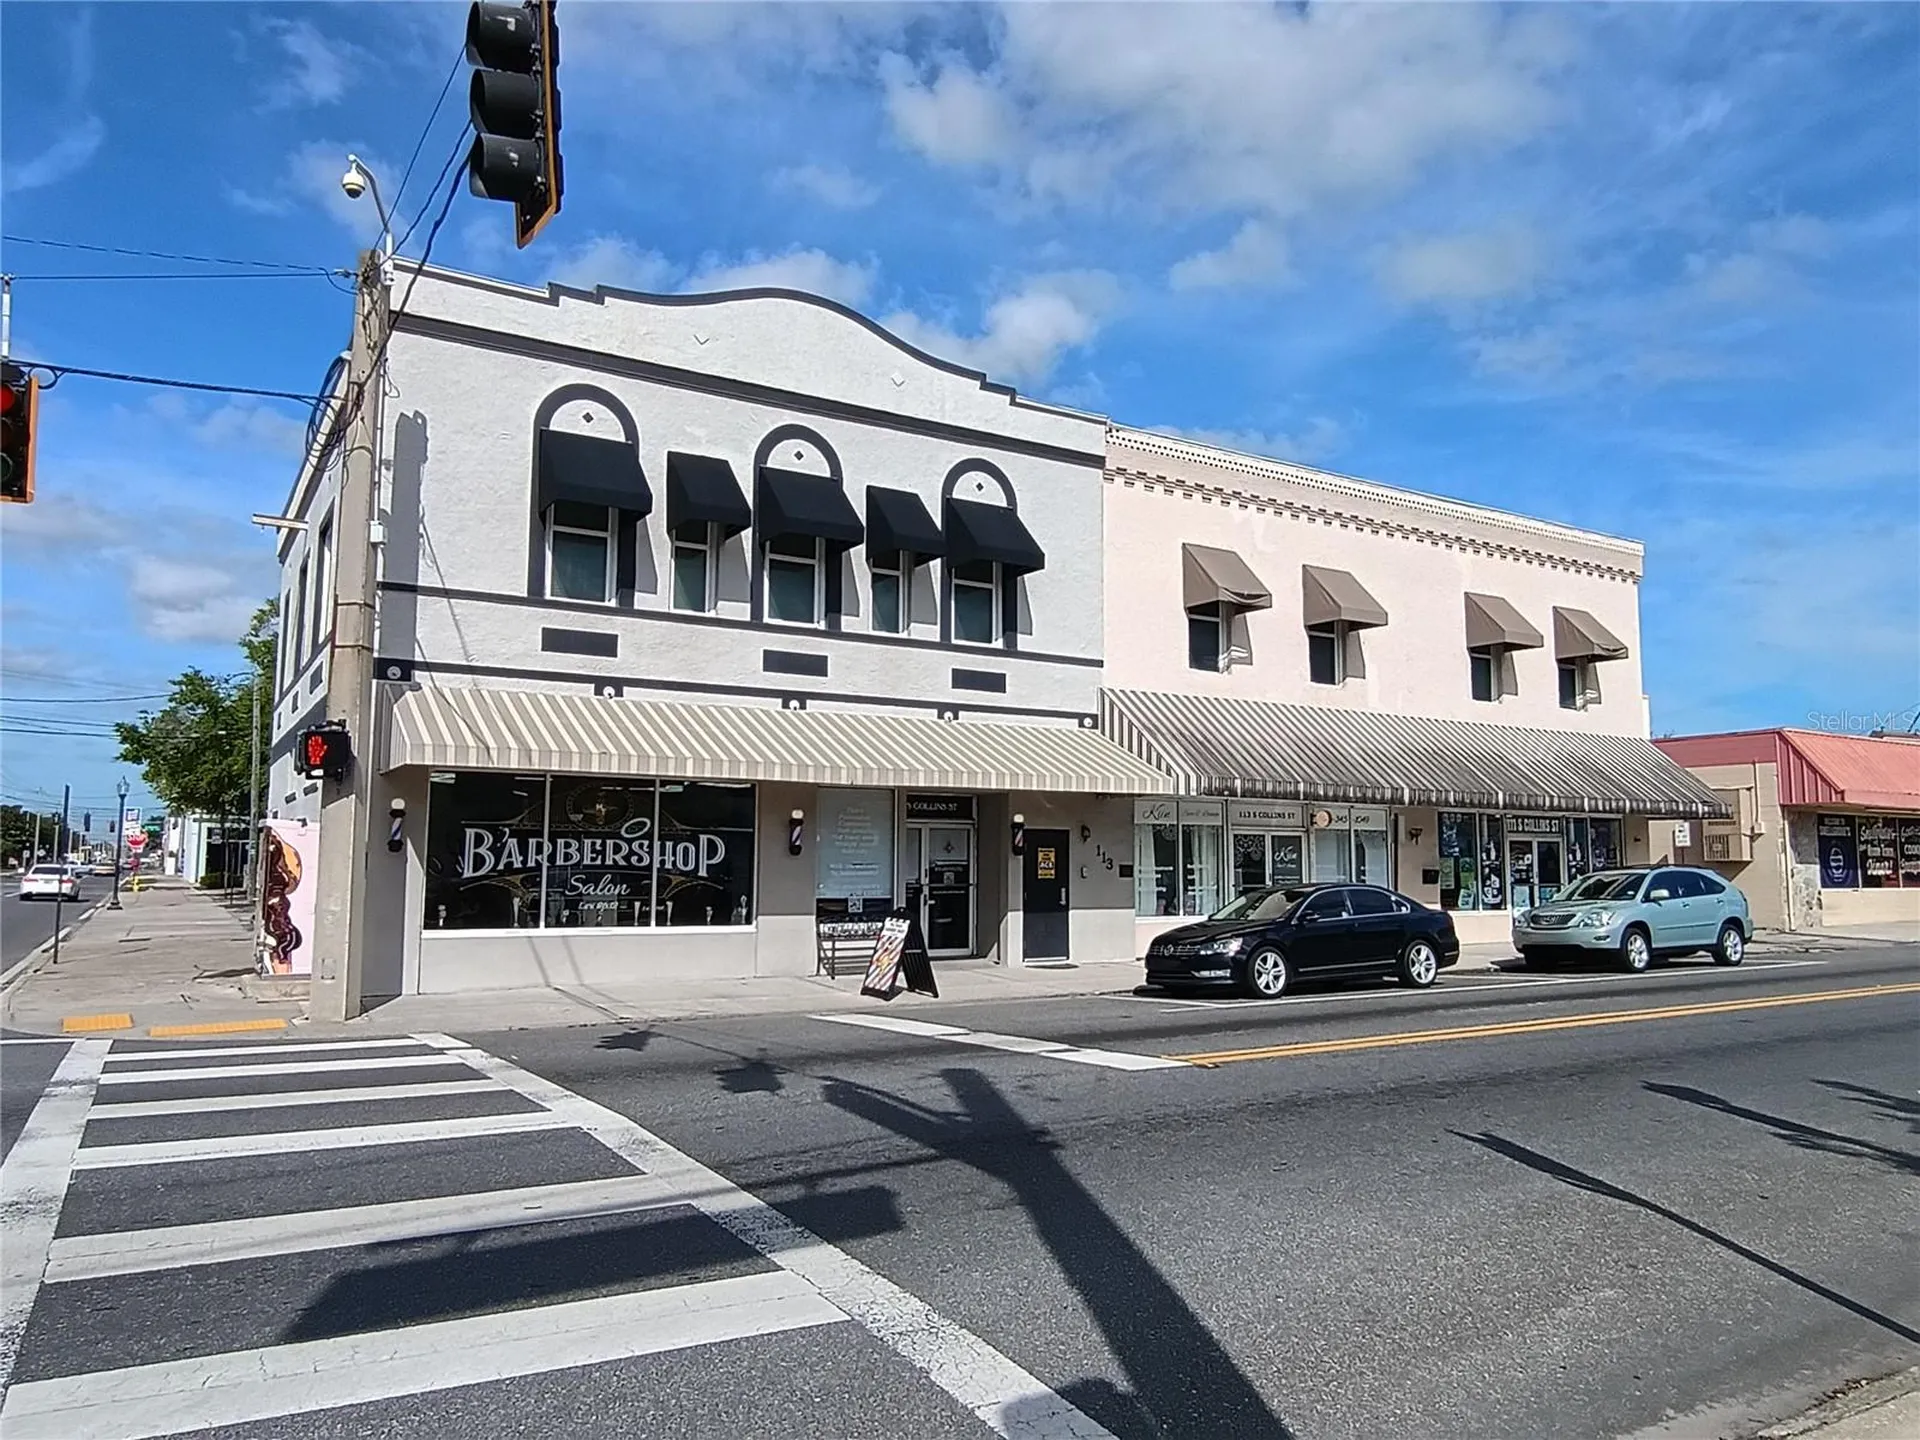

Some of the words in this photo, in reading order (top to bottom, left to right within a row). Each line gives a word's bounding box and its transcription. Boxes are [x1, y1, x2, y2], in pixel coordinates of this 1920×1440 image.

[1258, 811, 1286, 819] COLLINS
[1287, 812, 1296, 820] ST
[1524, 818, 1550, 832] COLLINS
[1551, 819, 1559, 832] ST
[1096, 844, 1113, 870] 113
[565, 873, 630, 896] Salon
